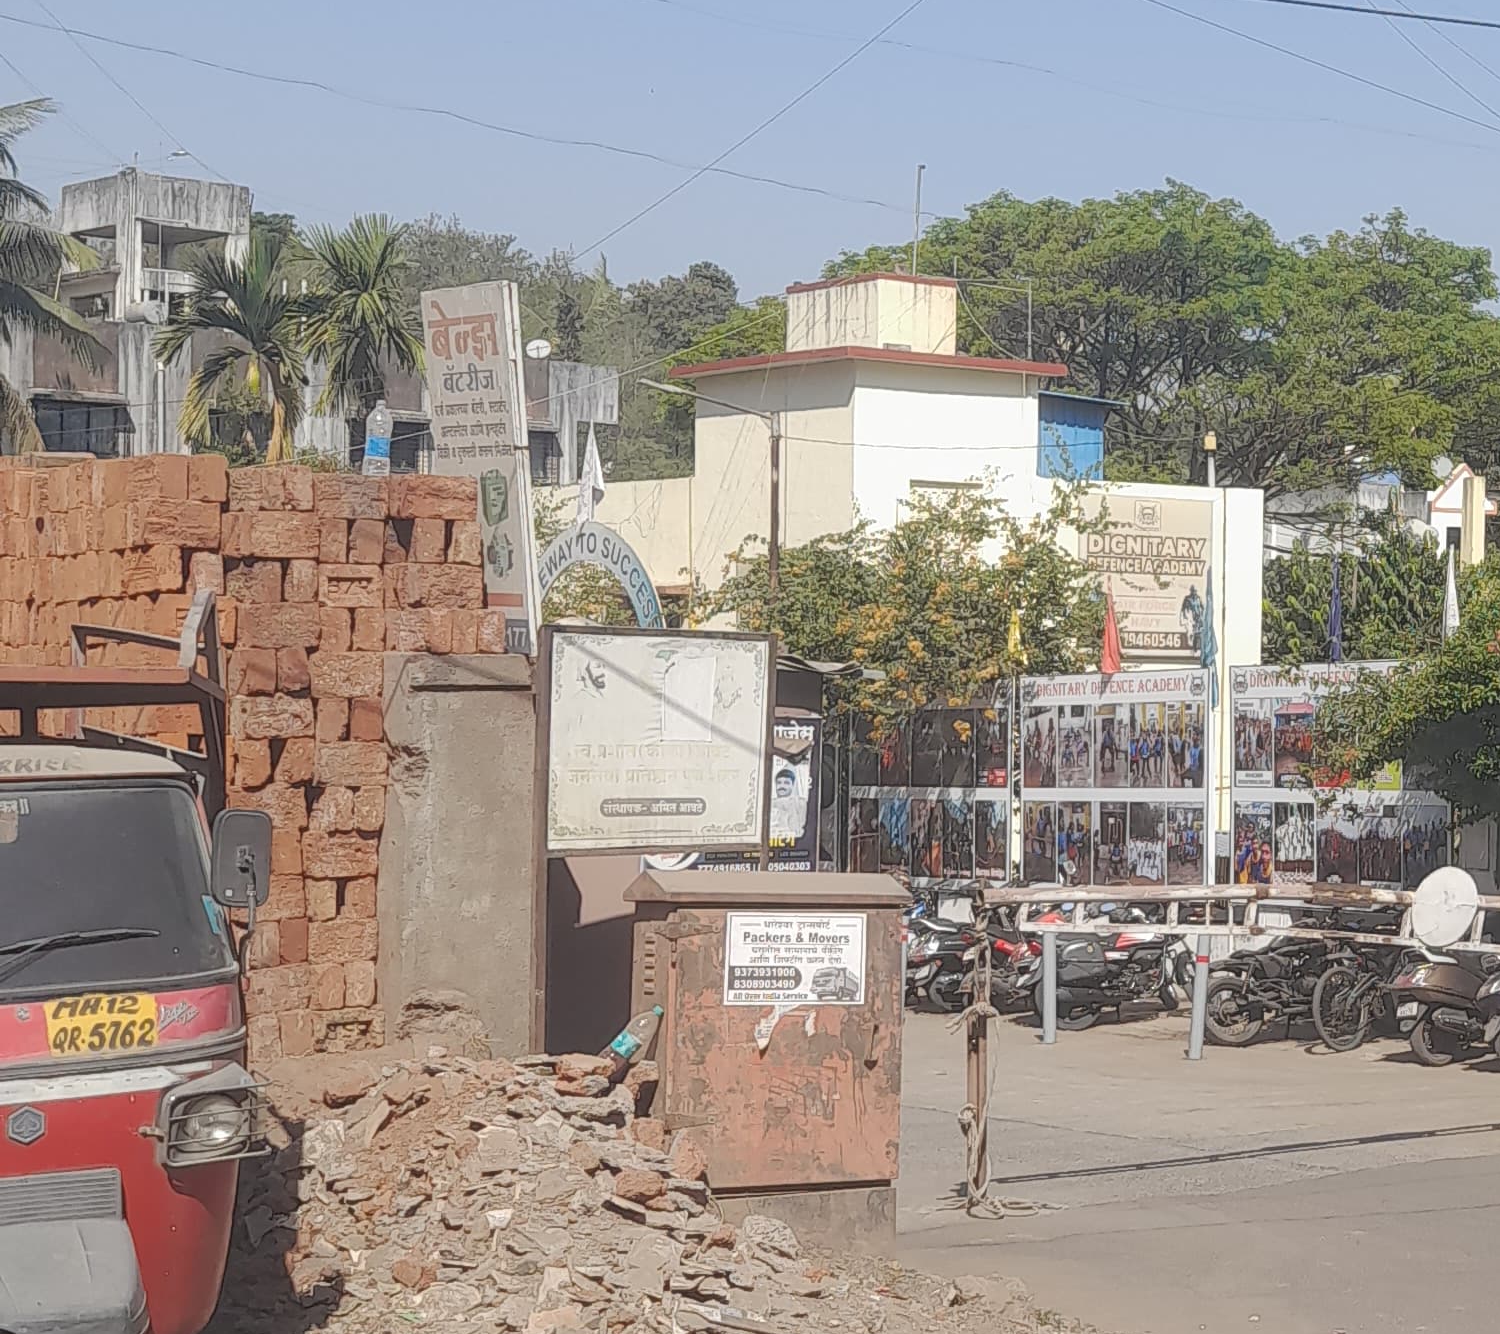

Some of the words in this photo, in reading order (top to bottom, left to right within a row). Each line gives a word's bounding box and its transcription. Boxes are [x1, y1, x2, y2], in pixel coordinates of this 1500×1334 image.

[576, 532, 597, 555] TO
[1088, 533, 1206, 559] DIGNITARY
[1088, 555, 1142, 573] DEFENCE
[1142, 557, 1206, 576] ACADEMY
[1036, 679, 1088, 698] DIGNITARY
[1091, 677, 1134, 695] DEFENCE
[1137, 674, 1190, 692] ACADEMY
[743, 931, 791, 943] Packers
[796, 932, 804, 943] &
[808, 932, 850, 944] Movers
